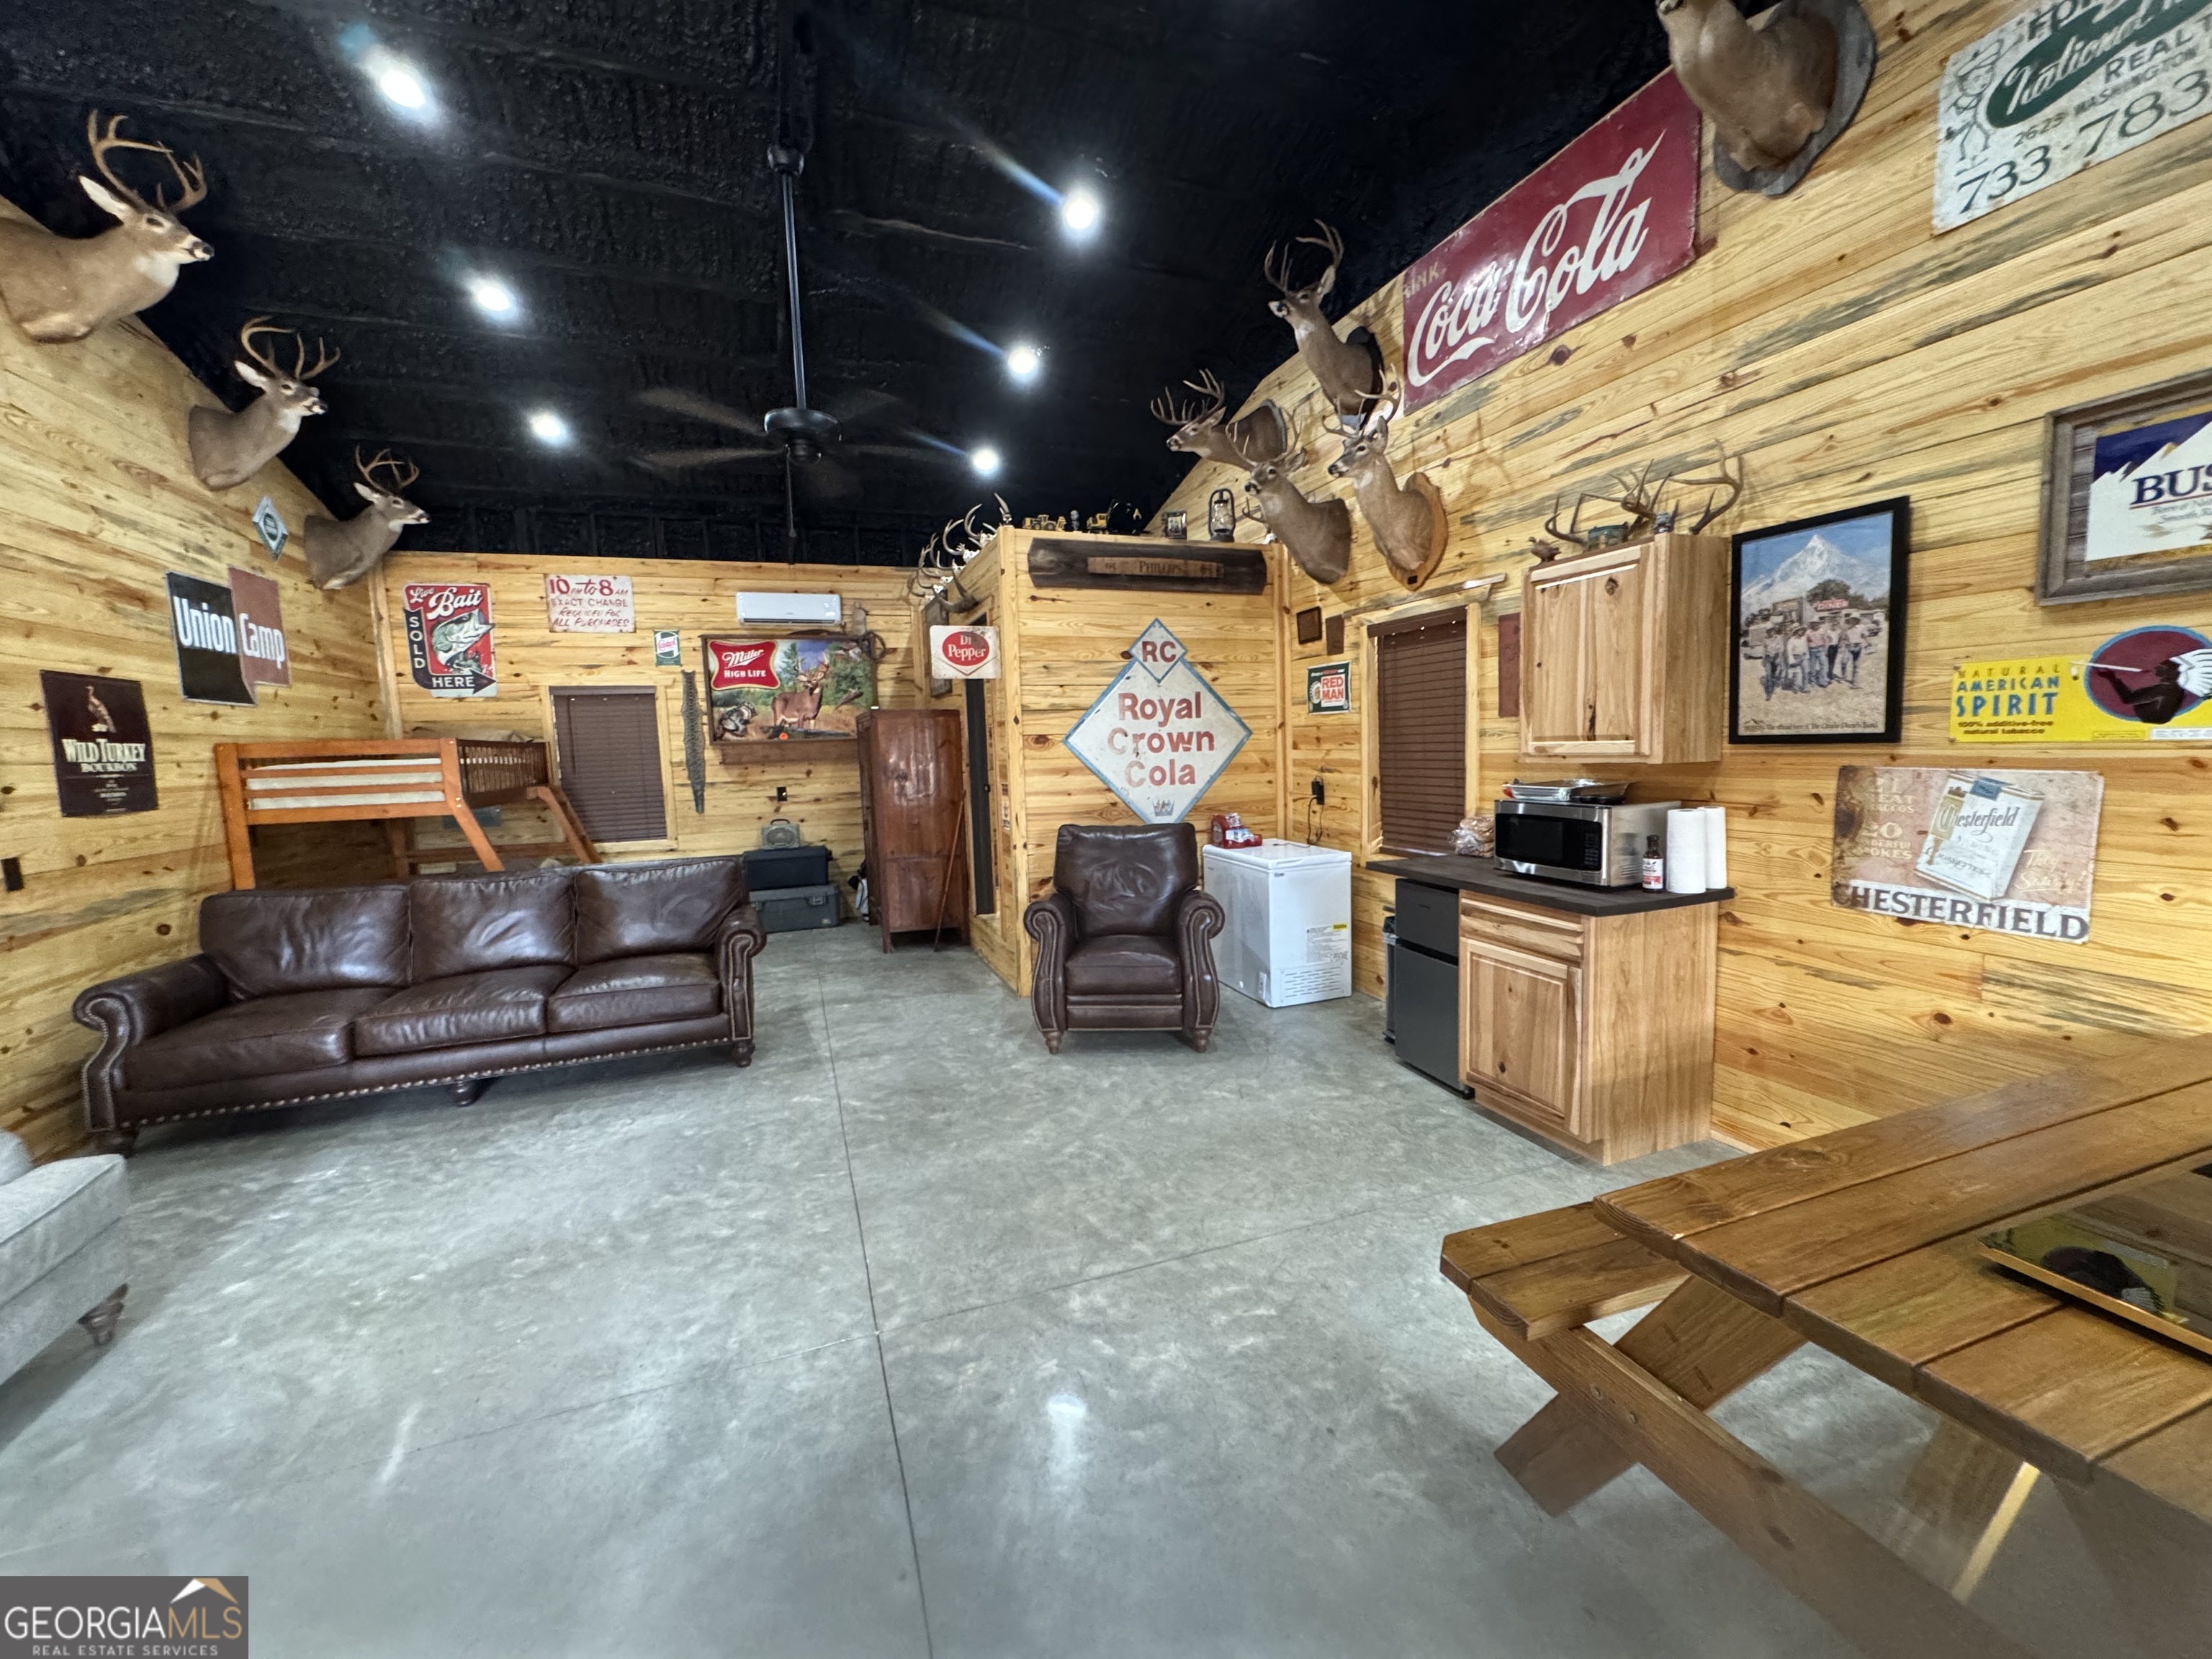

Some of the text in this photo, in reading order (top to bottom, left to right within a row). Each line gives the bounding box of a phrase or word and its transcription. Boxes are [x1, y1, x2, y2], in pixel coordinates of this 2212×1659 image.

[549, 578, 570, 595] 10
[575, 579, 598, 595] to
[599, 579, 613, 596] 8
[426, 587, 483, 620] Bait
[551, 598, 629, 607] EXACT CHANGE
[552, 618, 570, 626] ALL
[173, 595, 286, 670] Union Camp
[408, 616, 426, 669] SOLD
[1141, 640, 1177, 663] RC
[721, 649, 765, 667] Miller
[948, 644, 986, 662] Pepper
[1958, 664, 2060, 678] NATURAL
[432, 675, 475, 688] HERE
[1322, 676, 1344, 689] RED
[1956, 675, 2060, 693] AMERICAN
[1322, 687, 1344, 701] MAN
[1118, 691, 1202, 728] Royal
[1956, 692, 2059, 717] SPIRIT
[1107, 727, 1215, 755] Crown
[61, 738, 146, 763] WILD TURKEY
[80, 762, 138, 773] BOURBON
[1125, 759, 1196, 788] Cola
[1833, 881, 2090, 940] CHESTERFIELD
